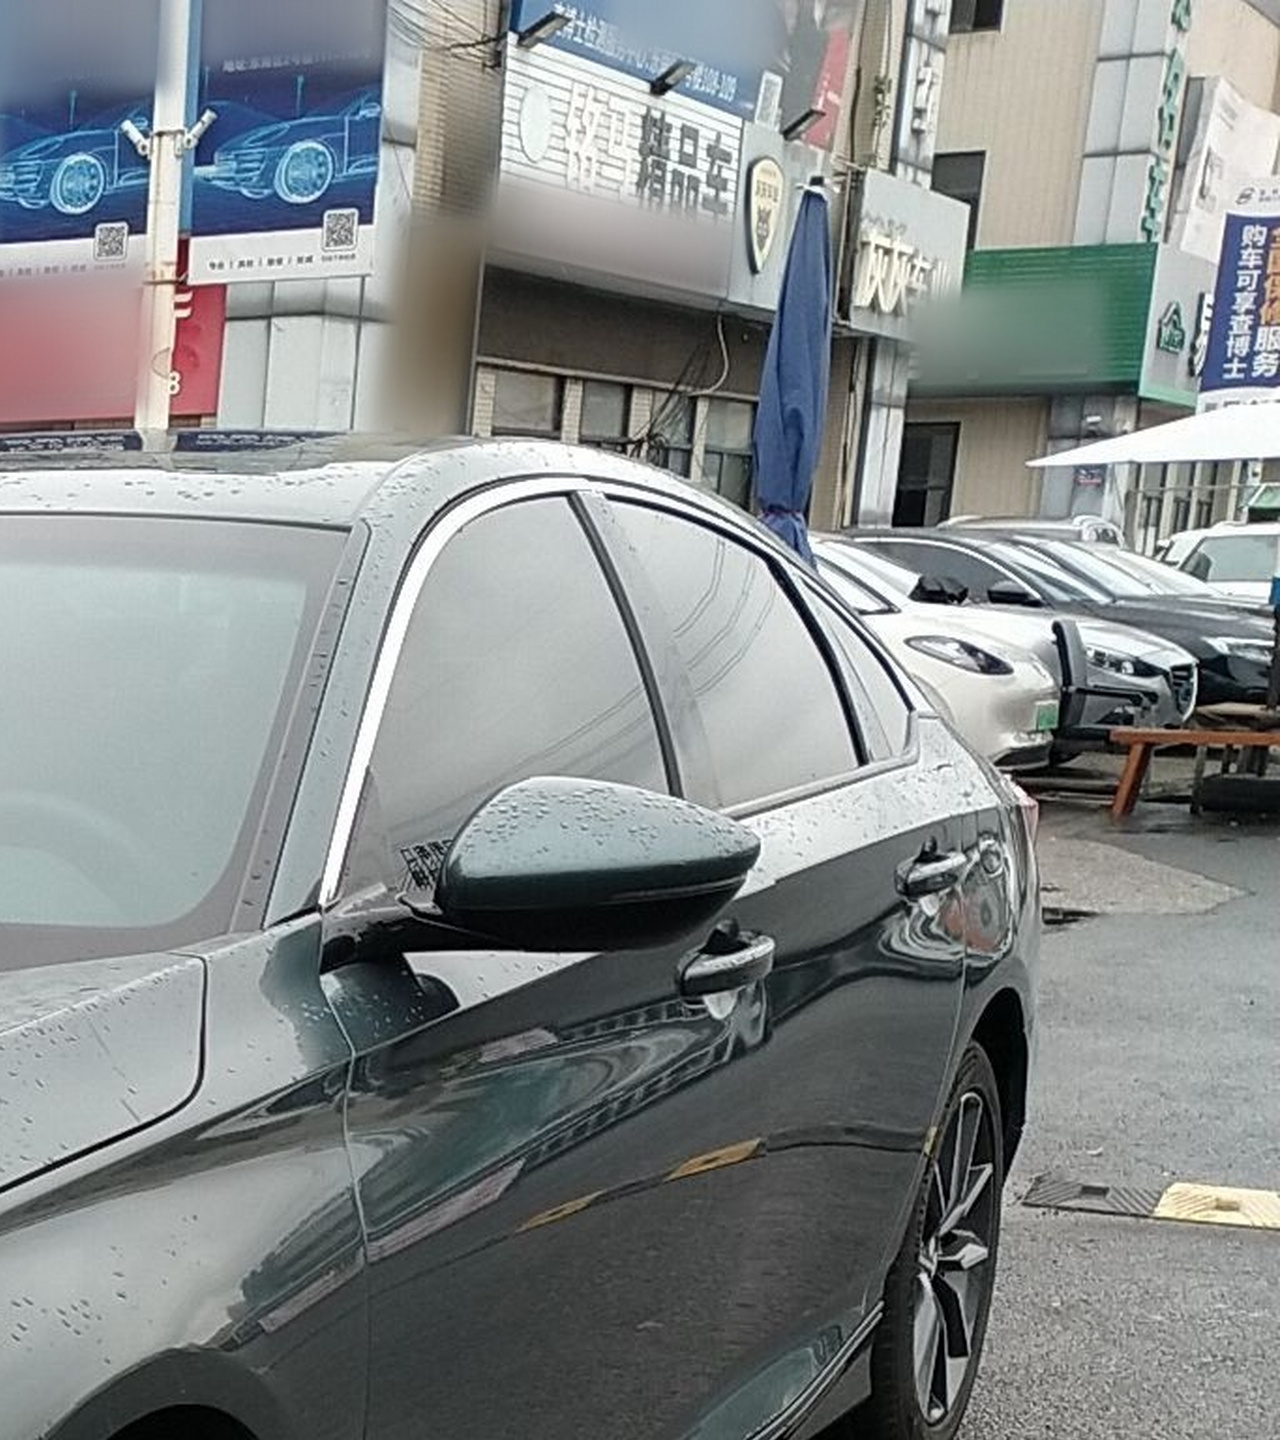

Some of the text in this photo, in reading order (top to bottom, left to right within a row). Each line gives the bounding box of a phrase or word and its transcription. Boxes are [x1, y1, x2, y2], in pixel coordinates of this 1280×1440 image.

[1223, 225, 1268, 380] 购车可享查博士
